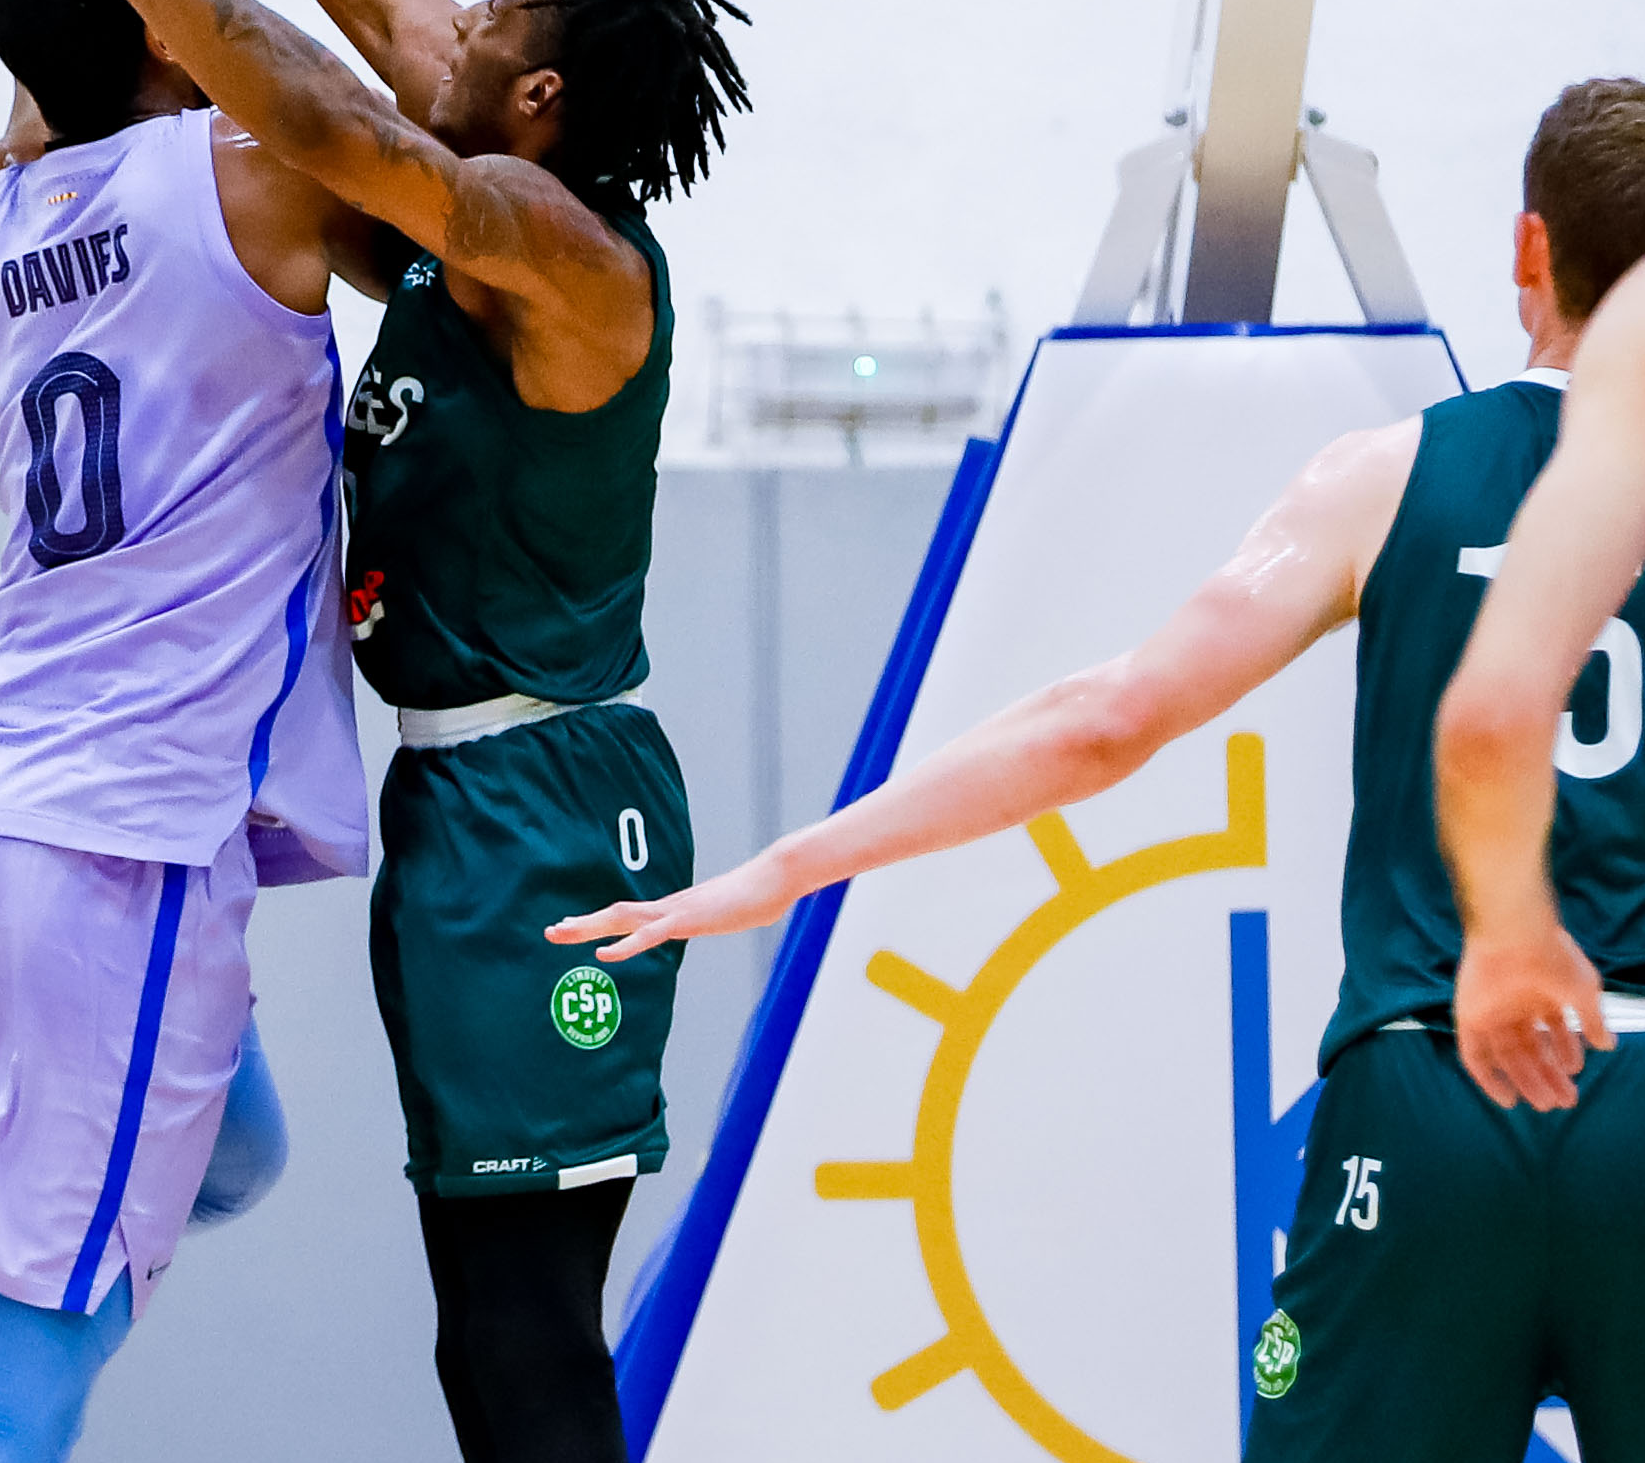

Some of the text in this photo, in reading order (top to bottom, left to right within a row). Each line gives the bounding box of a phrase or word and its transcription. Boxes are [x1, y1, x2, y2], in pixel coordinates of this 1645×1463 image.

[1, 223, 131, 319] DAVIES
[21, 351, 126, 569] 0
[616, 807, 650, 872] 0
[561, 982, 613, 1024] CSP
[473, 1158, 532, 1174] CRAFT
[1335, 1155, 1383, 1231] 15
